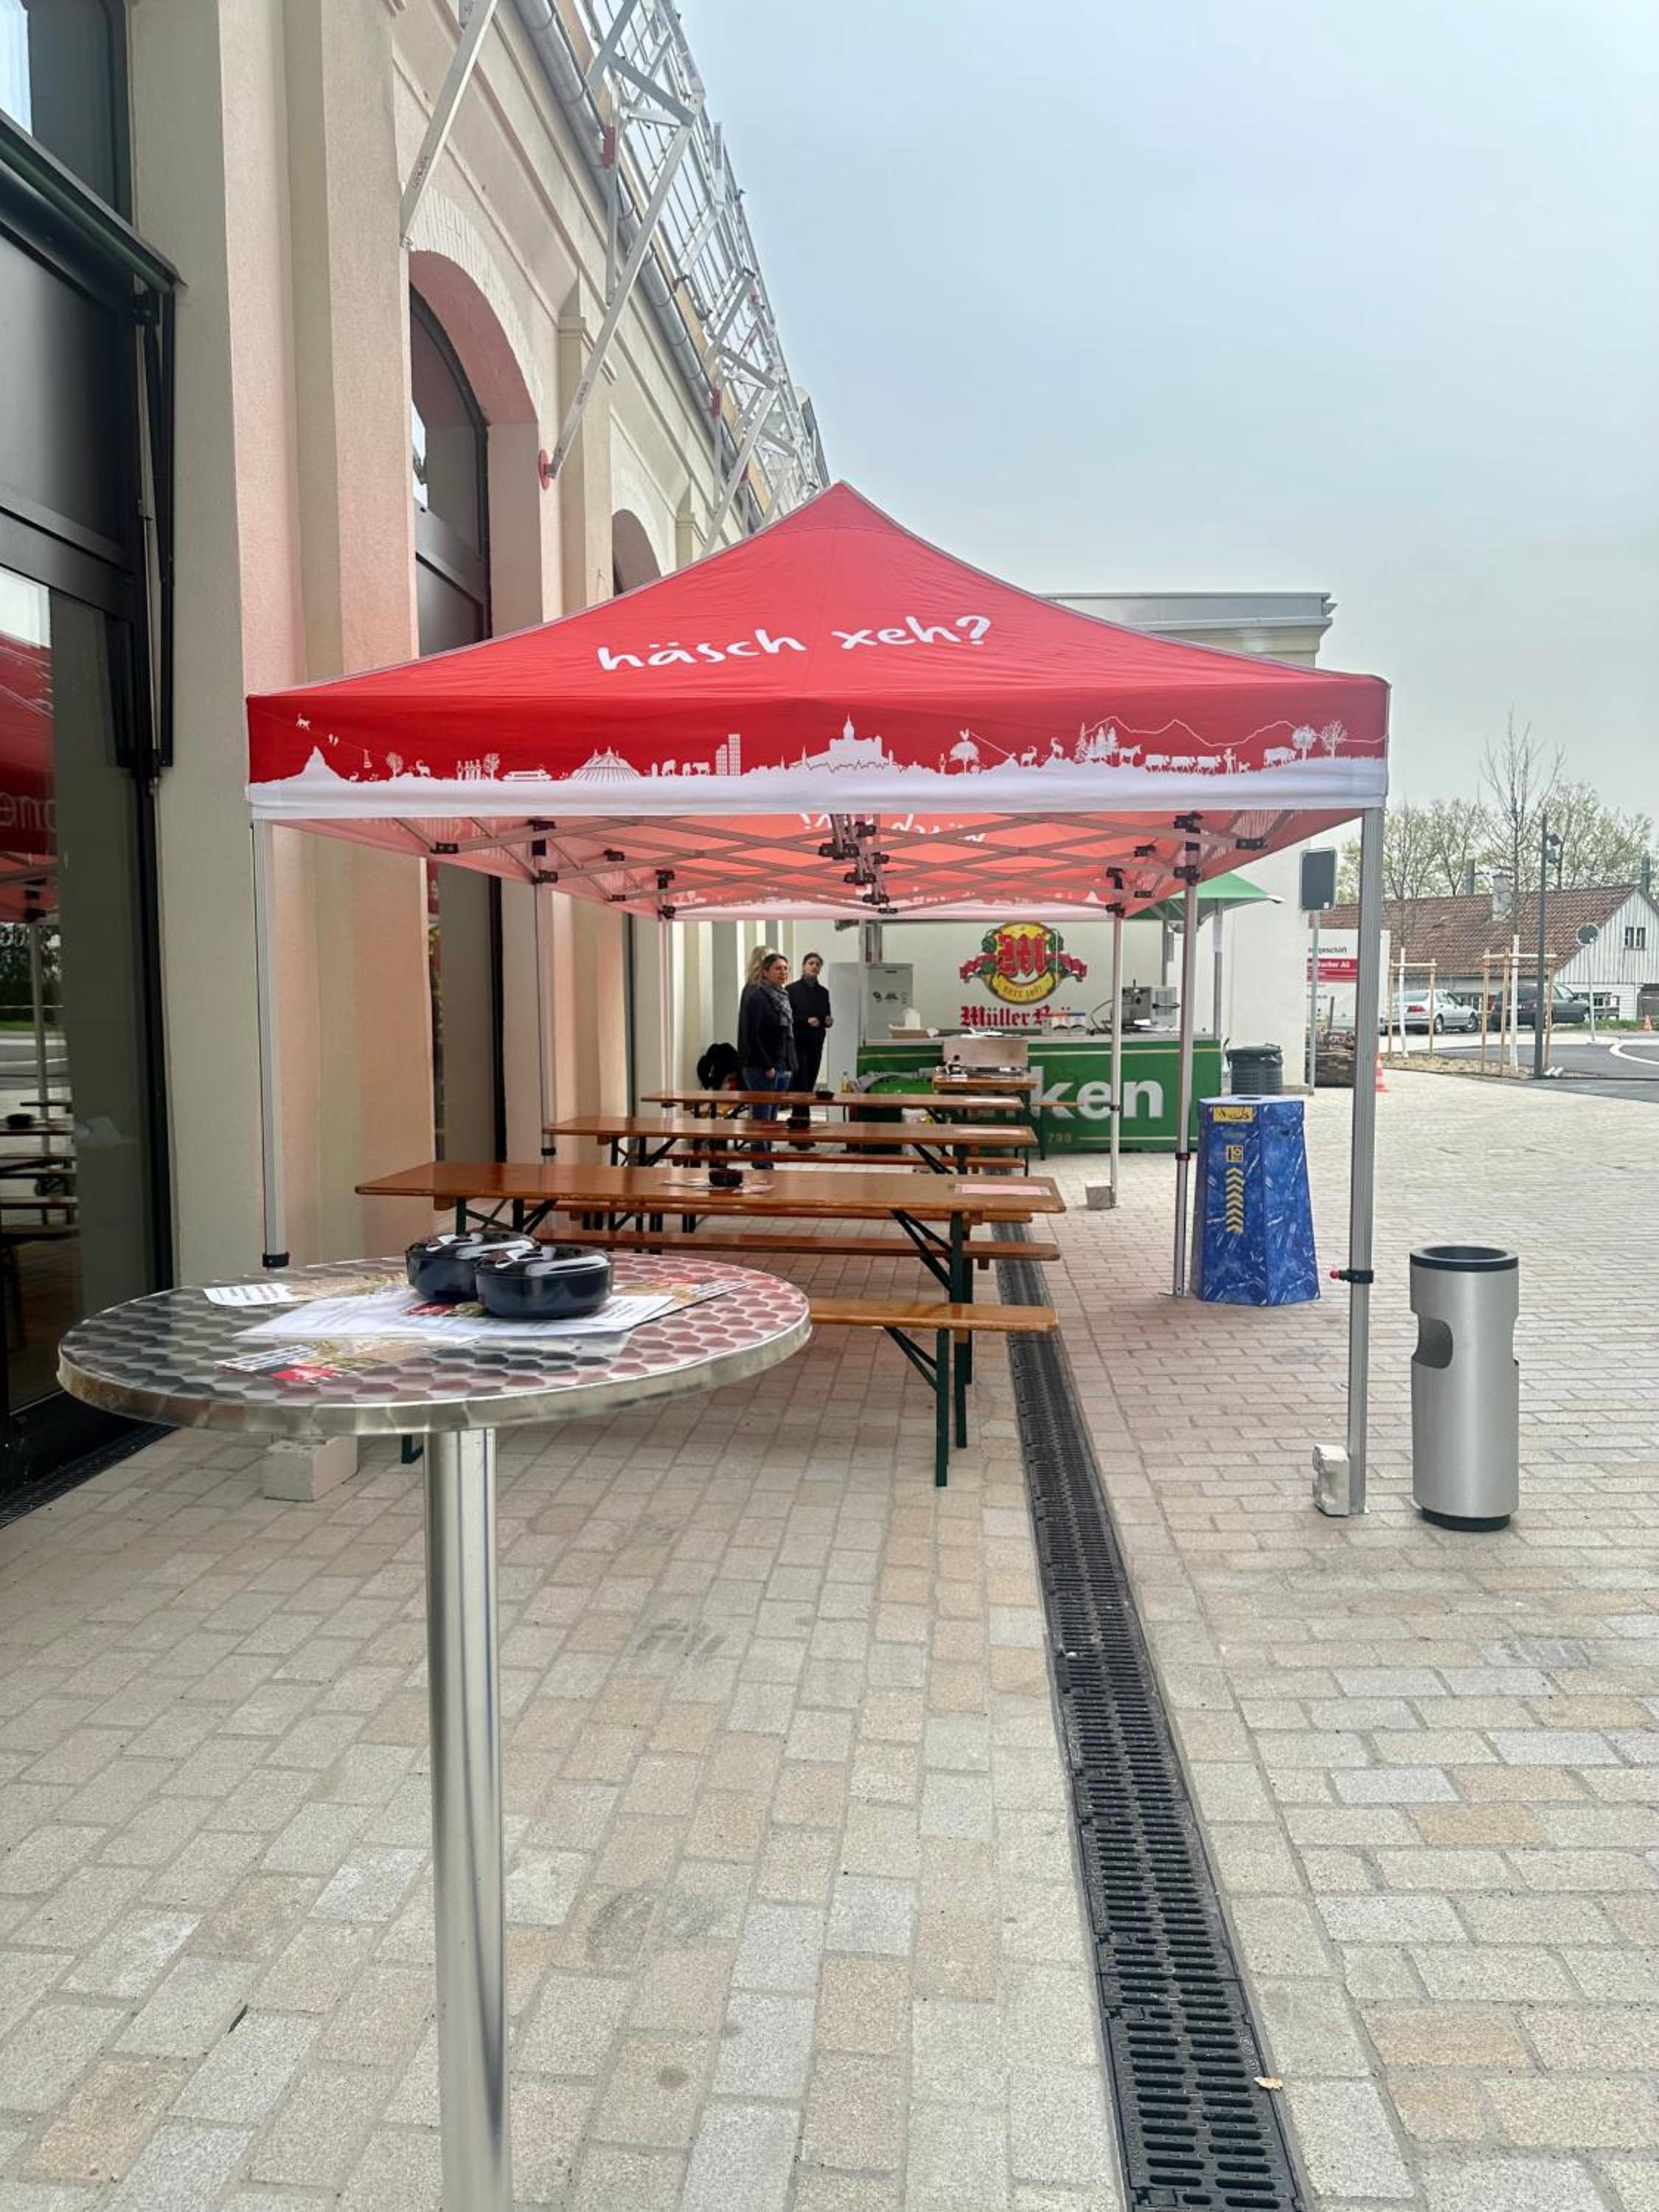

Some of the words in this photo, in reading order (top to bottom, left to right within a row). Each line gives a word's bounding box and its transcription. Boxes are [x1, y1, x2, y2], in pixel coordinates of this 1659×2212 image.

[597, 629, 807, 670] häsch
[831, 615, 991, 649] xeh?
[961, 1006, 1030, 1026] Müller
